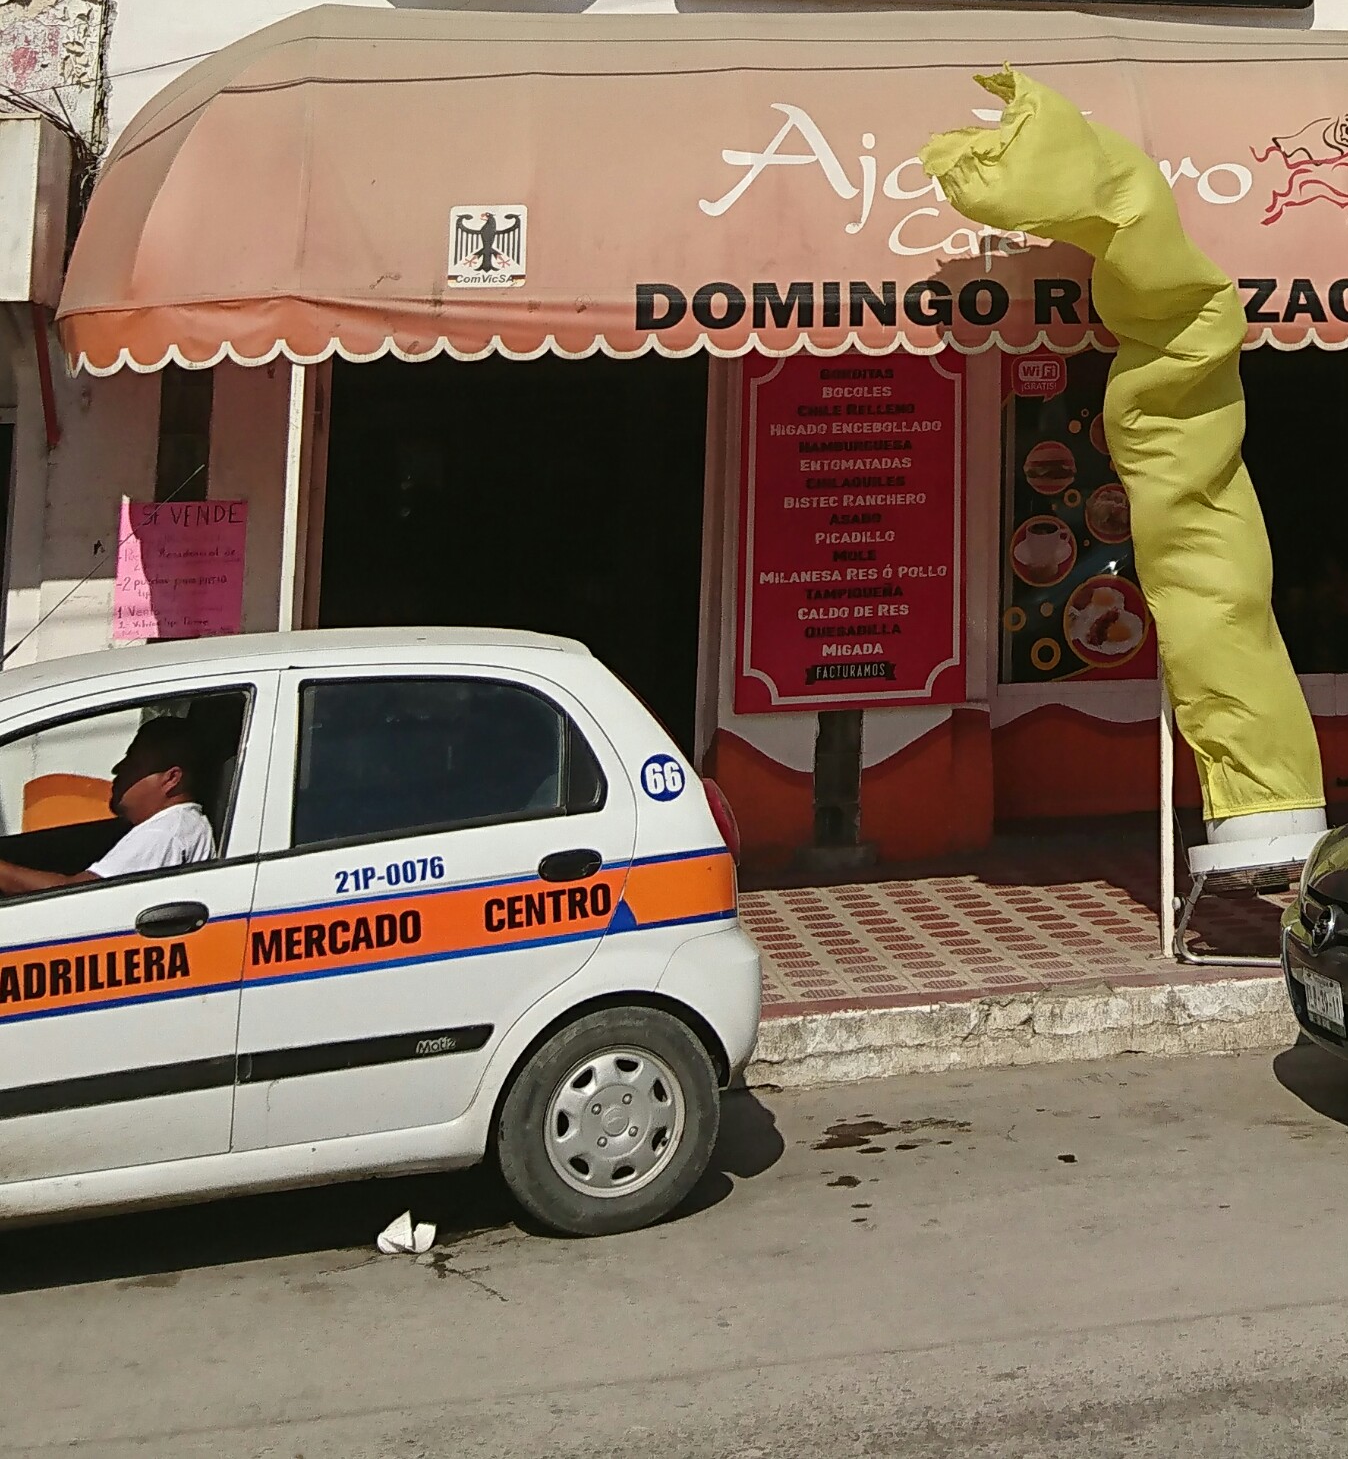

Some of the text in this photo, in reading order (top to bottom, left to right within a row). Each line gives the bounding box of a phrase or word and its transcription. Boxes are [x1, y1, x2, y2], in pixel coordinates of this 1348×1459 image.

[455, 274, 514, 284] ComVicSA
[635, 279, 1009, 331] DOMINGO
[822, 386, 892, 398] BOCOLES
[832, 420, 942, 435] ENCEBOLLADO
[800, 457, 912, 472] ENTOMATADAS
[784, 493, 926, 509] BISTEC RANCHERO
[171, 502, 244, 528] VENDE
[815, 530, 895, 544] PICADILLO
[759, 569, 842, 584] MILANESA
[846, 567, 878, 581] RES
[898, 564, 947, 578] POLLO
[798, 603, 909, 621] CALDO DE RES
[822, 642, 884, 657] MIGADA
[816, 662, 886, 679] FACTURAMOS
[643, 760, 682, 796] 66
[334, 855, 446, 896] 21P-0076
[0, 883, 612, 1004] ADRILLERA MERCADO CENTRO
